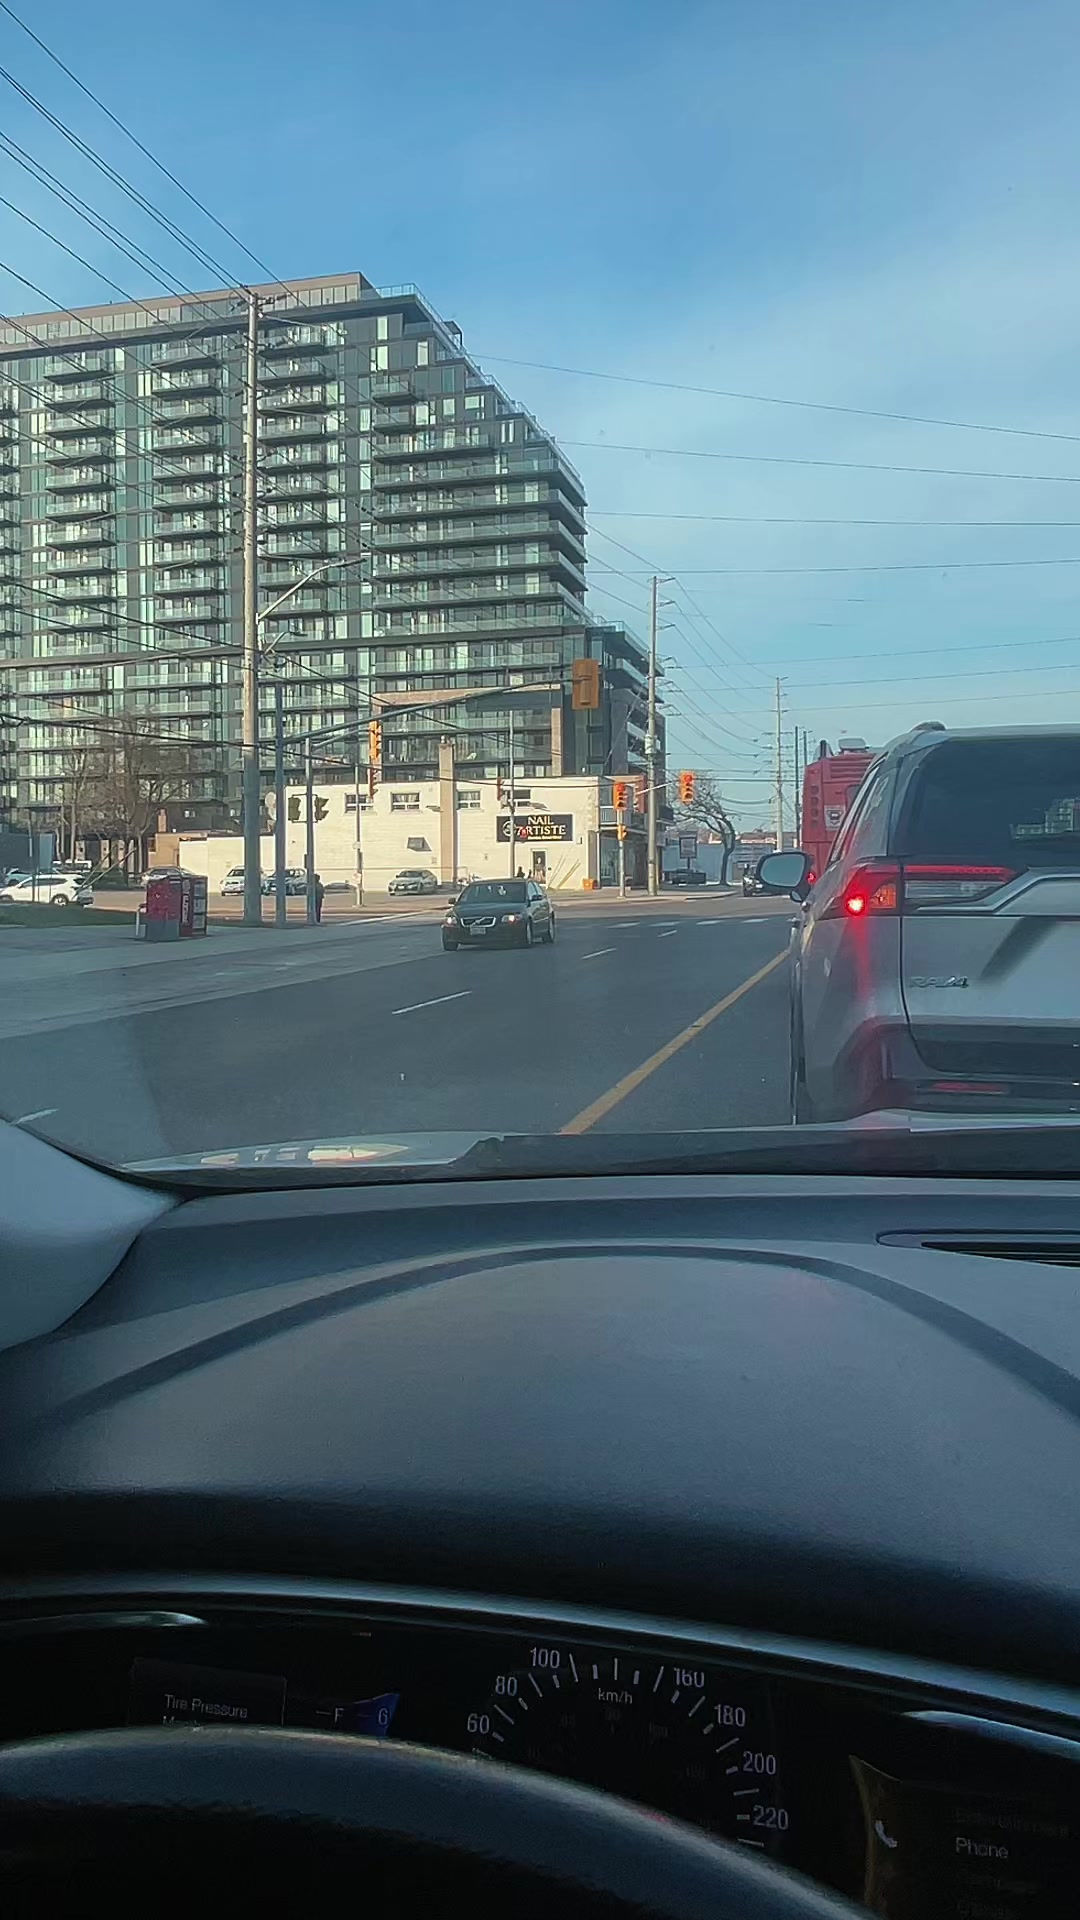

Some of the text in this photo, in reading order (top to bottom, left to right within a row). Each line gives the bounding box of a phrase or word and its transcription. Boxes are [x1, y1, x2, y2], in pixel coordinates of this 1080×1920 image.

[528, 816, 554, 825] NAIL
[529, 1647, 560, 1669] 100
[495, 1675, 518, 1697] 80
[673, 1667, 705, 1688] 160
[164, 1694, 248, 1719] Tire Pressure
[598, 1688, 633, 1705] km/h
[333, 1707, 344, 1723] F
[467, 1713, 490, 1734] 60
[714, 1704, 746, 1727] 180
[742, 1751, 776, 1775] 200
[752, 1804, 789, 1830] 220
[955, 1837, 1009, 1859] Phone
